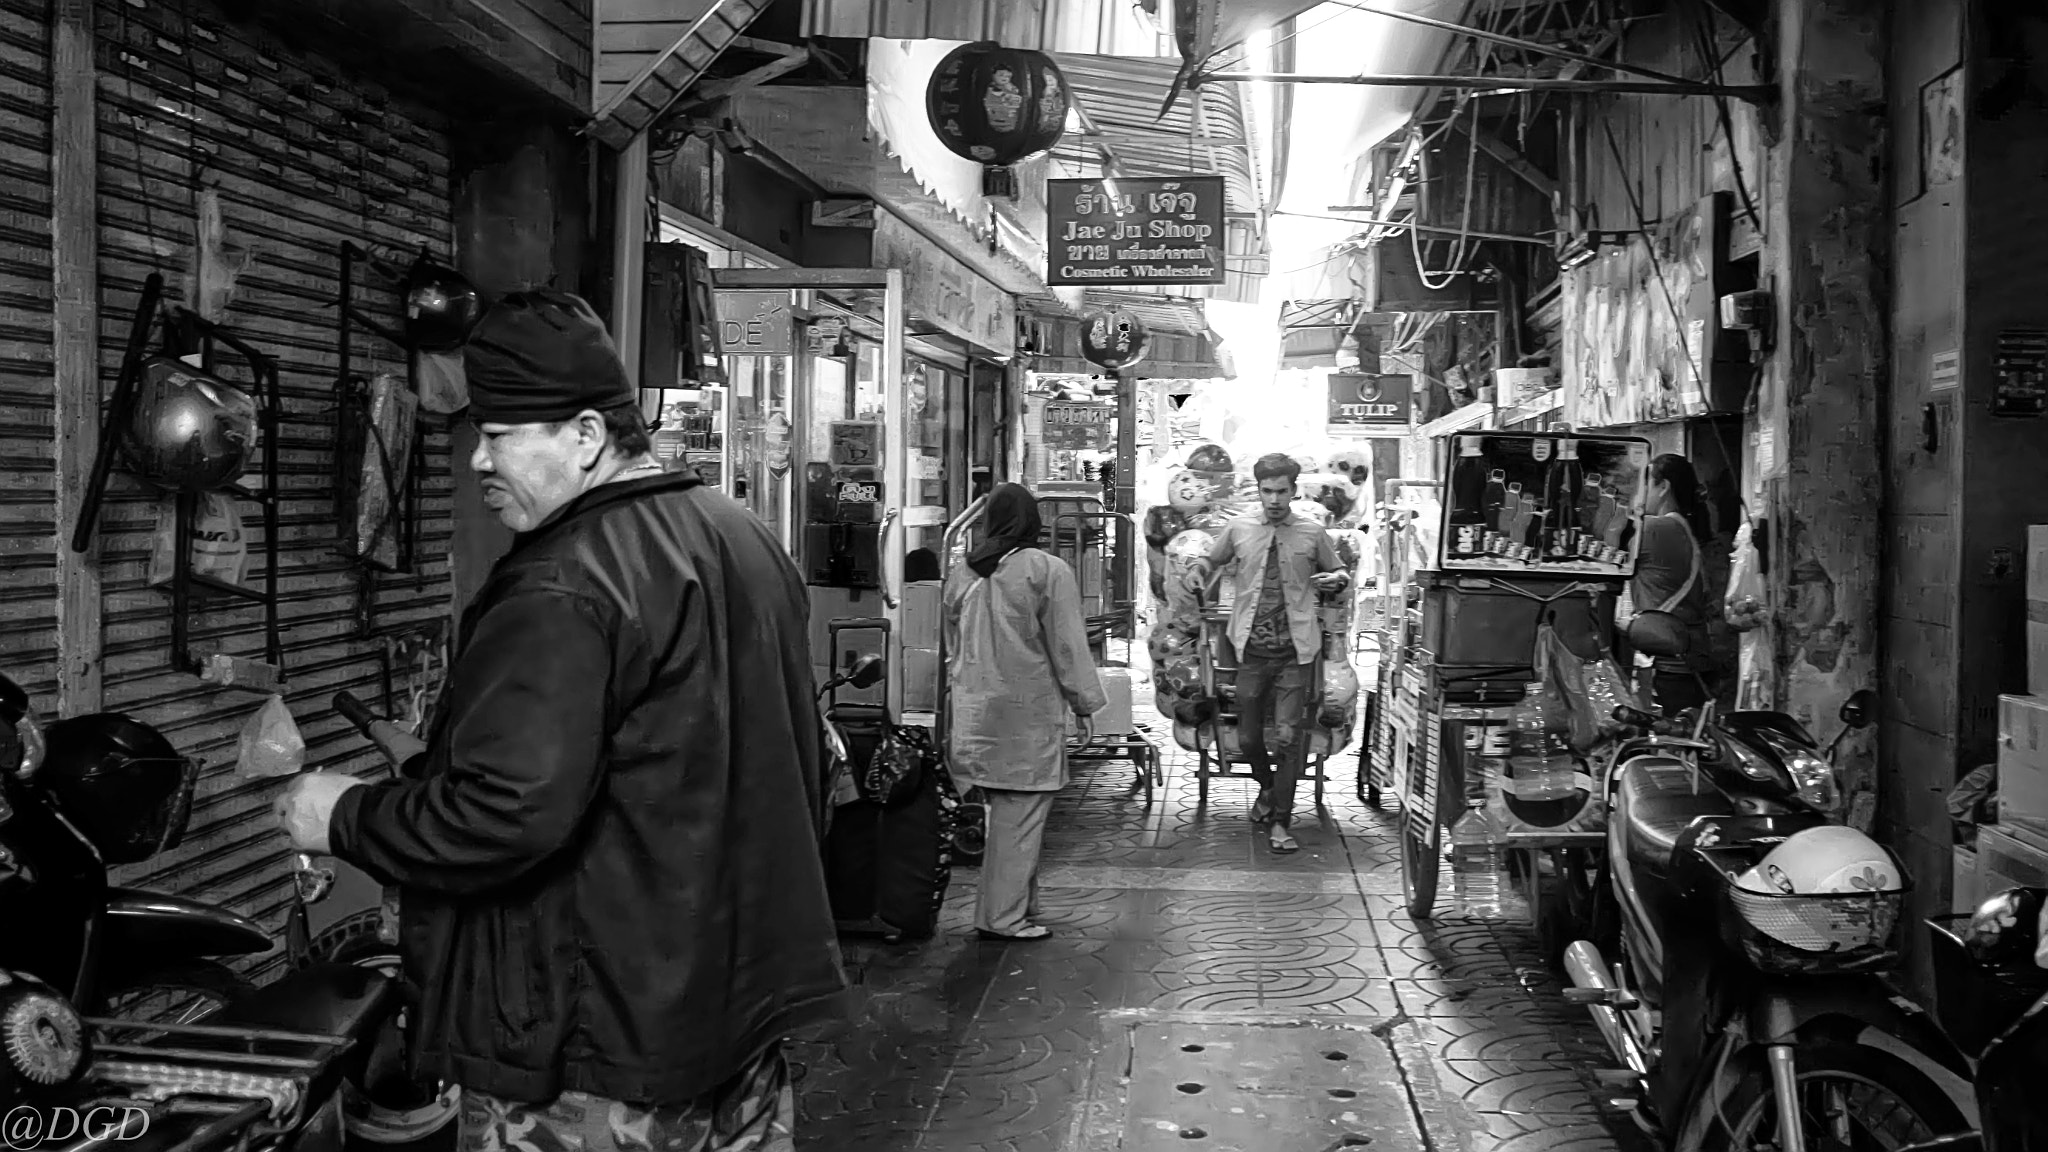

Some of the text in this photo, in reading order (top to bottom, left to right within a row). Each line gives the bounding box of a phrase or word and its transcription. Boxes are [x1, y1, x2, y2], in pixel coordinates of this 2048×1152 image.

[1062, 219, 1212, 242] Jae Ju Shop
[1067, 244, 1110, 261] ขาย
[1060, 264, 1215, 278] Cosmetic Wholesaler
[1340, 403, 1399, 416] TULIP
